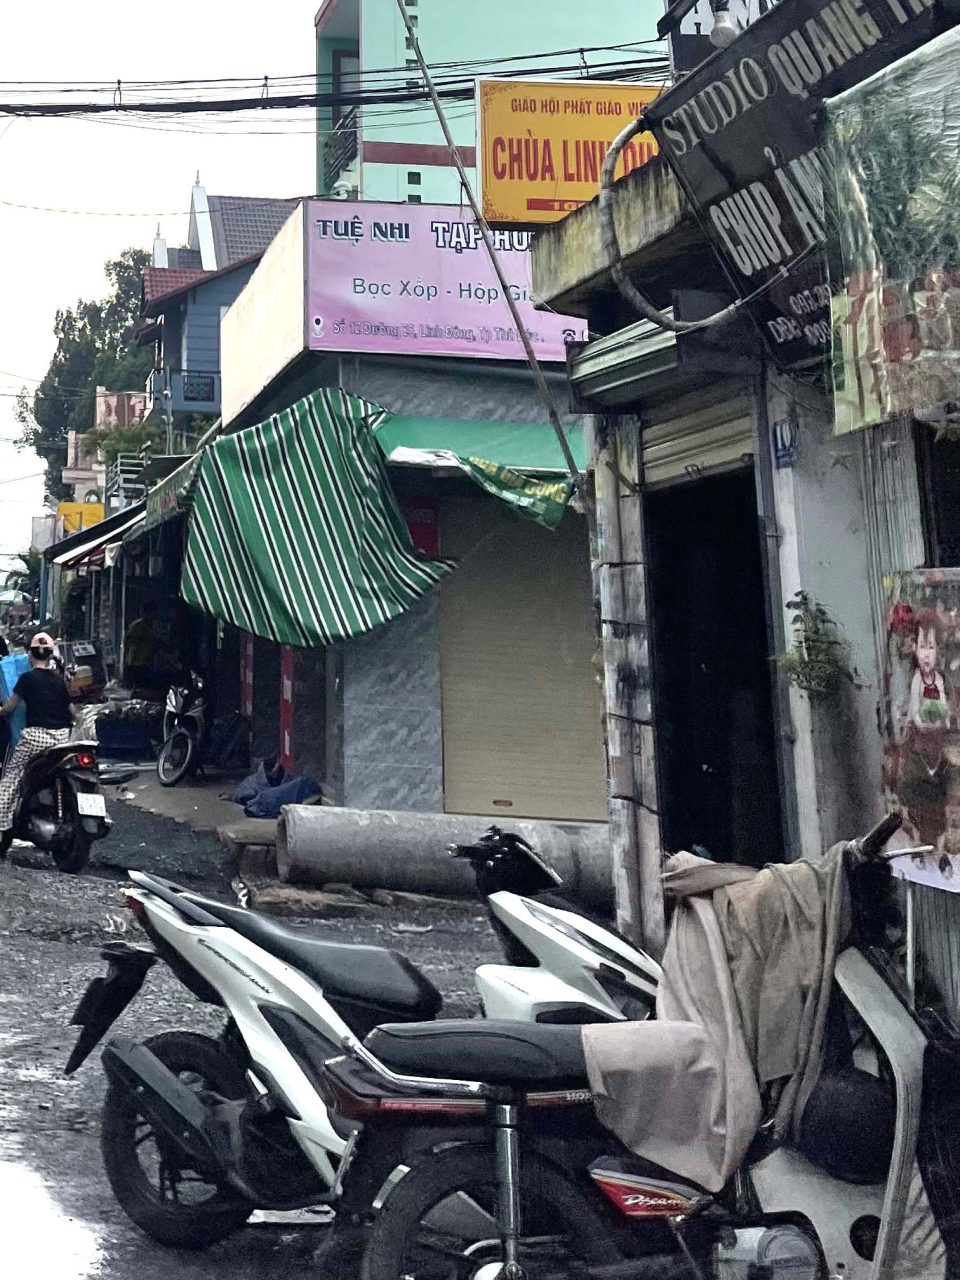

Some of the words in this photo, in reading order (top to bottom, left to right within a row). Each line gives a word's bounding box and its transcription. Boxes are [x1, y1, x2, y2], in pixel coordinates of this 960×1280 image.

[662, 58, 768, 155] STUDIO
[493, 129, 556, 182] CHÙA
[316, 215, 363, 246] TUỆ
[371, 222, 410, 242] NHI
[431, 221, 484, 254] TẠP
[353, 278, 391, 299] Bọc
[399, 276, 438, 301] Xốp
[459, 282, 499, 304] Hộp
